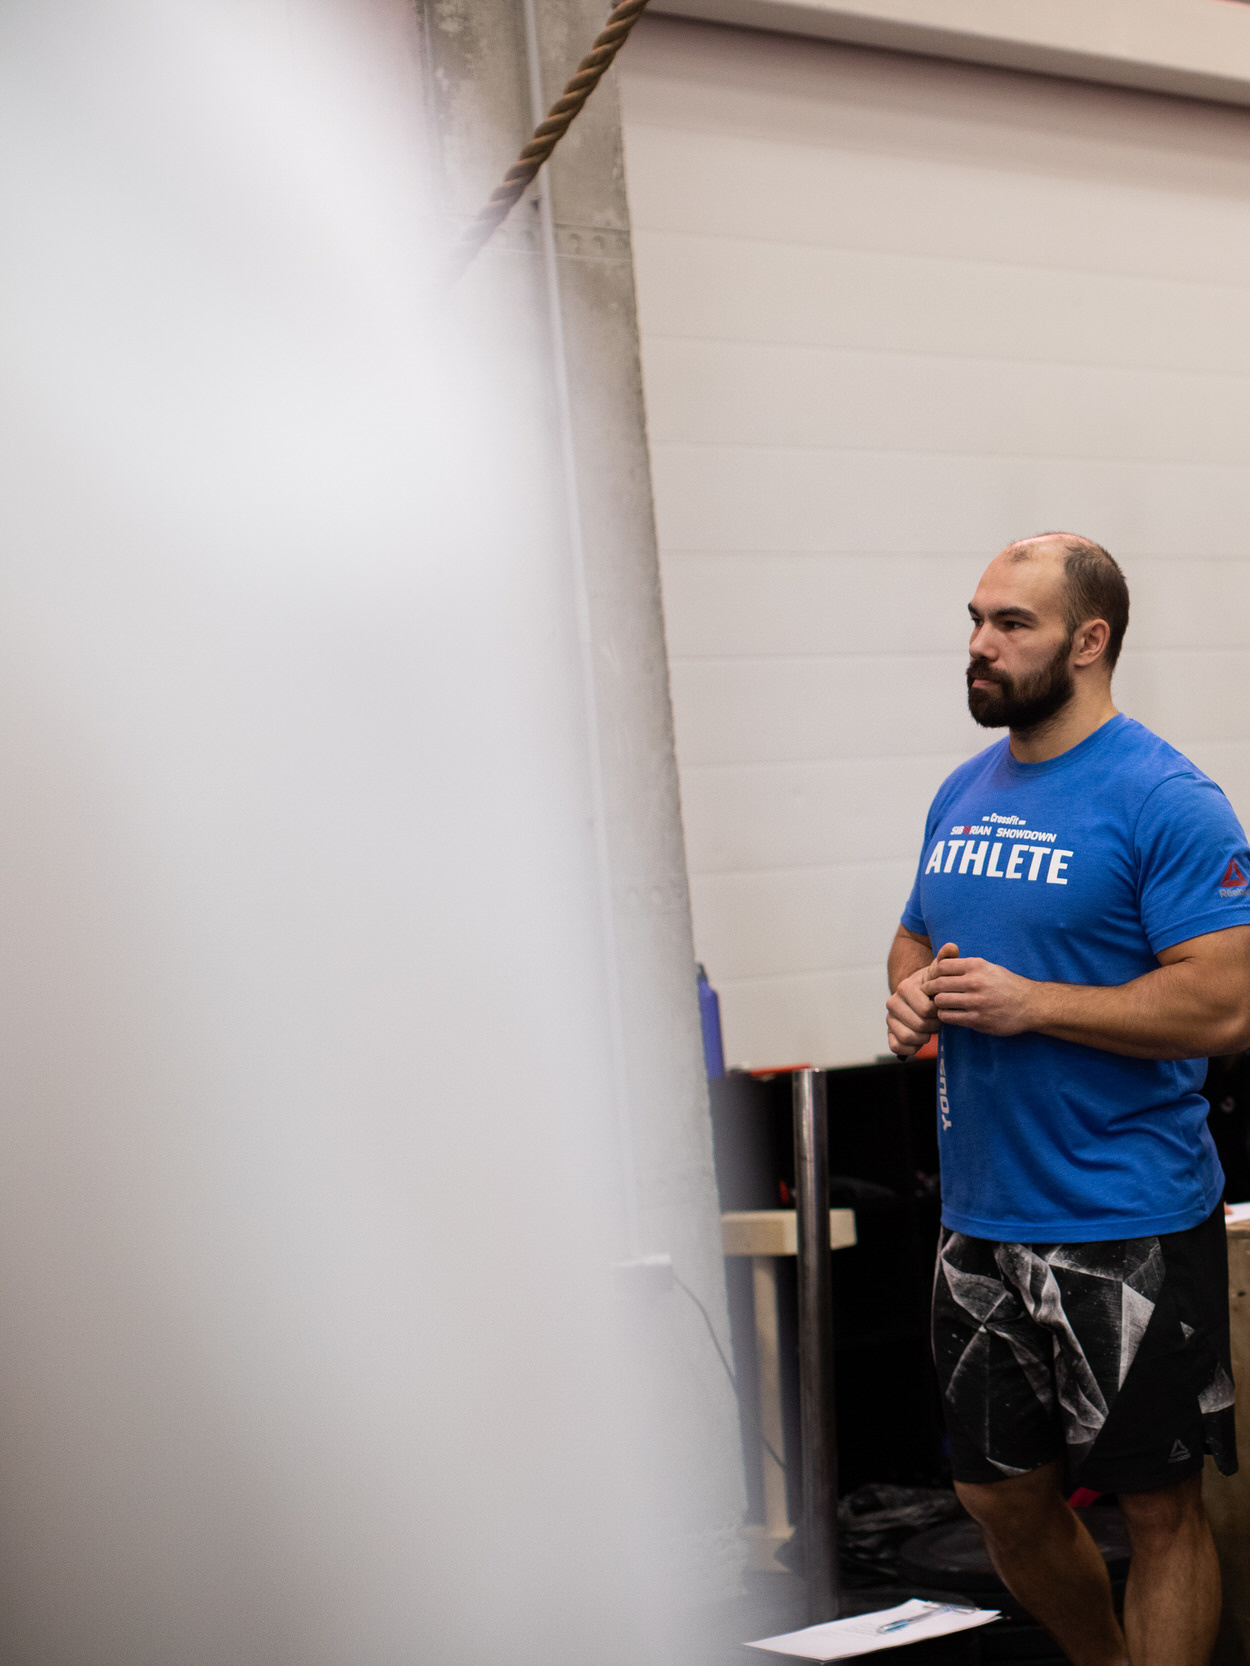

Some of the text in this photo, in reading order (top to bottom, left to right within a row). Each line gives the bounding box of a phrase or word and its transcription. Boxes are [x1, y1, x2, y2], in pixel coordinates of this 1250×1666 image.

[990, 812, 1020, 825] CrossFit
[995, 827, 1057, 843] SHOWDOWN
[925, 840, 1074, 885] ATHLETE
